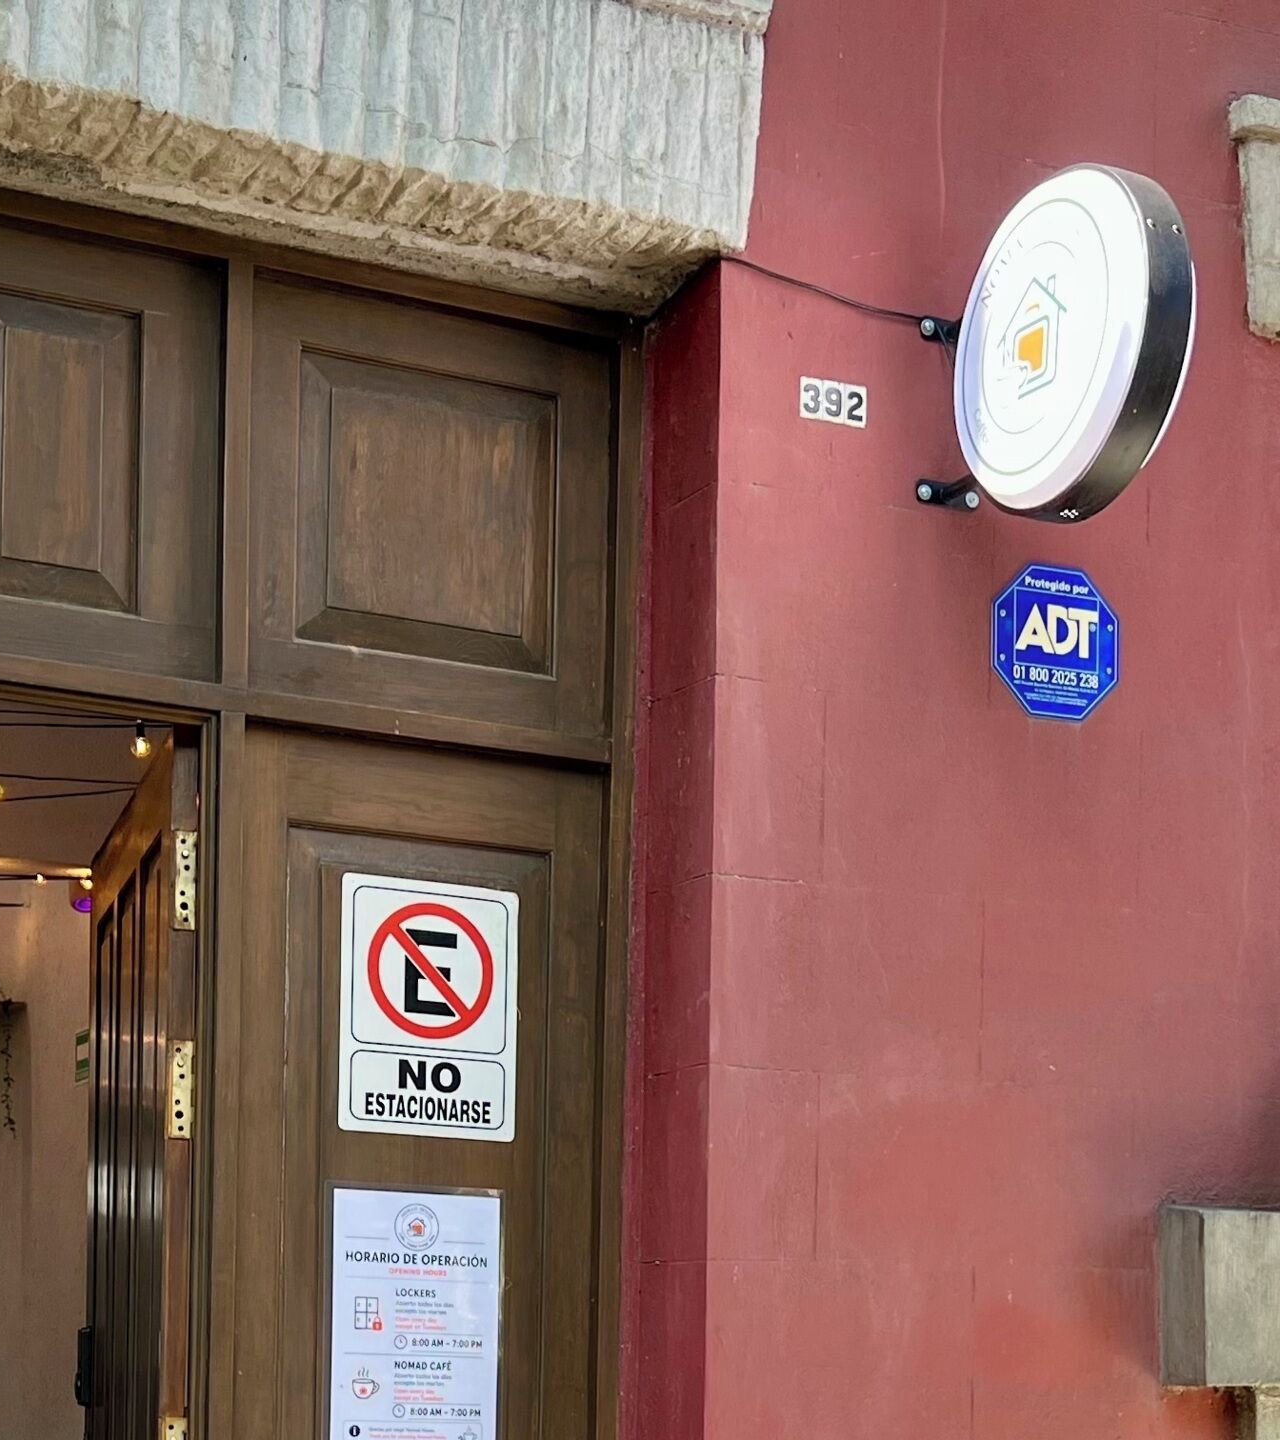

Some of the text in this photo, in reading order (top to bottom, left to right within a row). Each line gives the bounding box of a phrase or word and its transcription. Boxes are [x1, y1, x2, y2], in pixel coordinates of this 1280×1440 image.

[803, 383, 863, 422] 392
[1025, 575, 1089, 595] Protegido por
[1014, 602, 1099, 659] ADT
[1013, 665, 1026, 679] 01
[1029, 667, 1049, 682] 800
[1051, 669, 1077, 686] 2025
[1079, 672, 1099, 689] 238
[398, 1058, 461, 1093] NO
[365, 1092, 491, 1124] ESTACIONARSE
[345, 1250, 488, 1268] HORARIO DE OPERACIÓN
[388, 1267, 448, 1277] OPENING HOURS
[395, 1288, 437, 1298] LOCKERS
[431, 1339, 444, 1347] AM
[452, 1339, 469, 1348] 7:00
[471, 1340, 483, 1349] PM
[394, 1360, 452, 1371] NOMAD CAFÉ
[429, 1408, 442, 1416] AM
[450, 1408, 467, 1416] 7:00
[469, 1409, 481, 1417] PM
